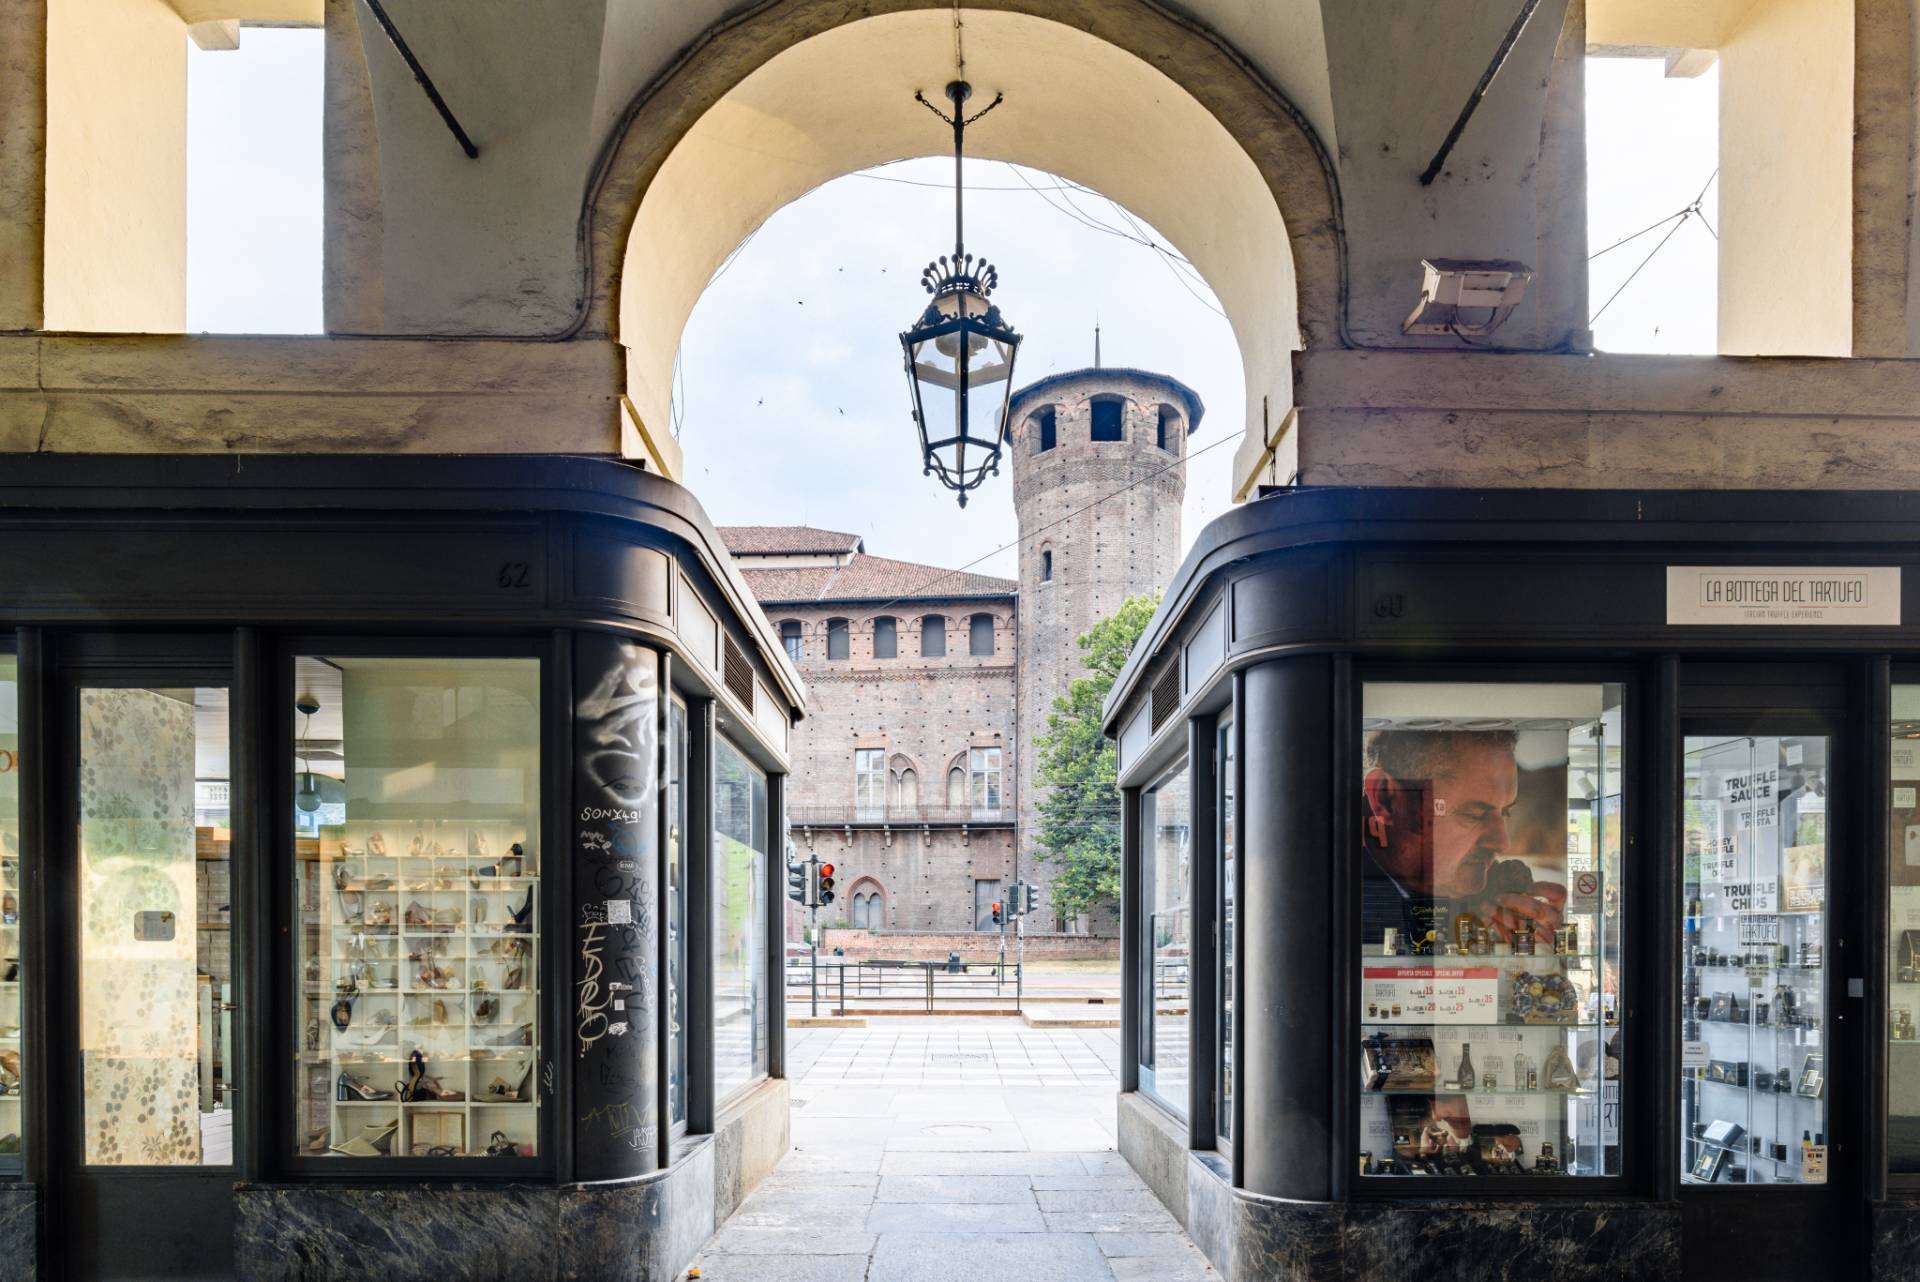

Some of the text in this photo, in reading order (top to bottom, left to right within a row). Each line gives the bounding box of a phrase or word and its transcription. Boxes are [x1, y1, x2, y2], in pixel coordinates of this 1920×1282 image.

[498, 560, 531, 588] 62
[1706, 580, 1862, 602] LA BOTTEGA DEL TARTUFO
[1741, 807, 1776, 821] TRFFLE
[1744, 817, 1771, 829] PSTA
